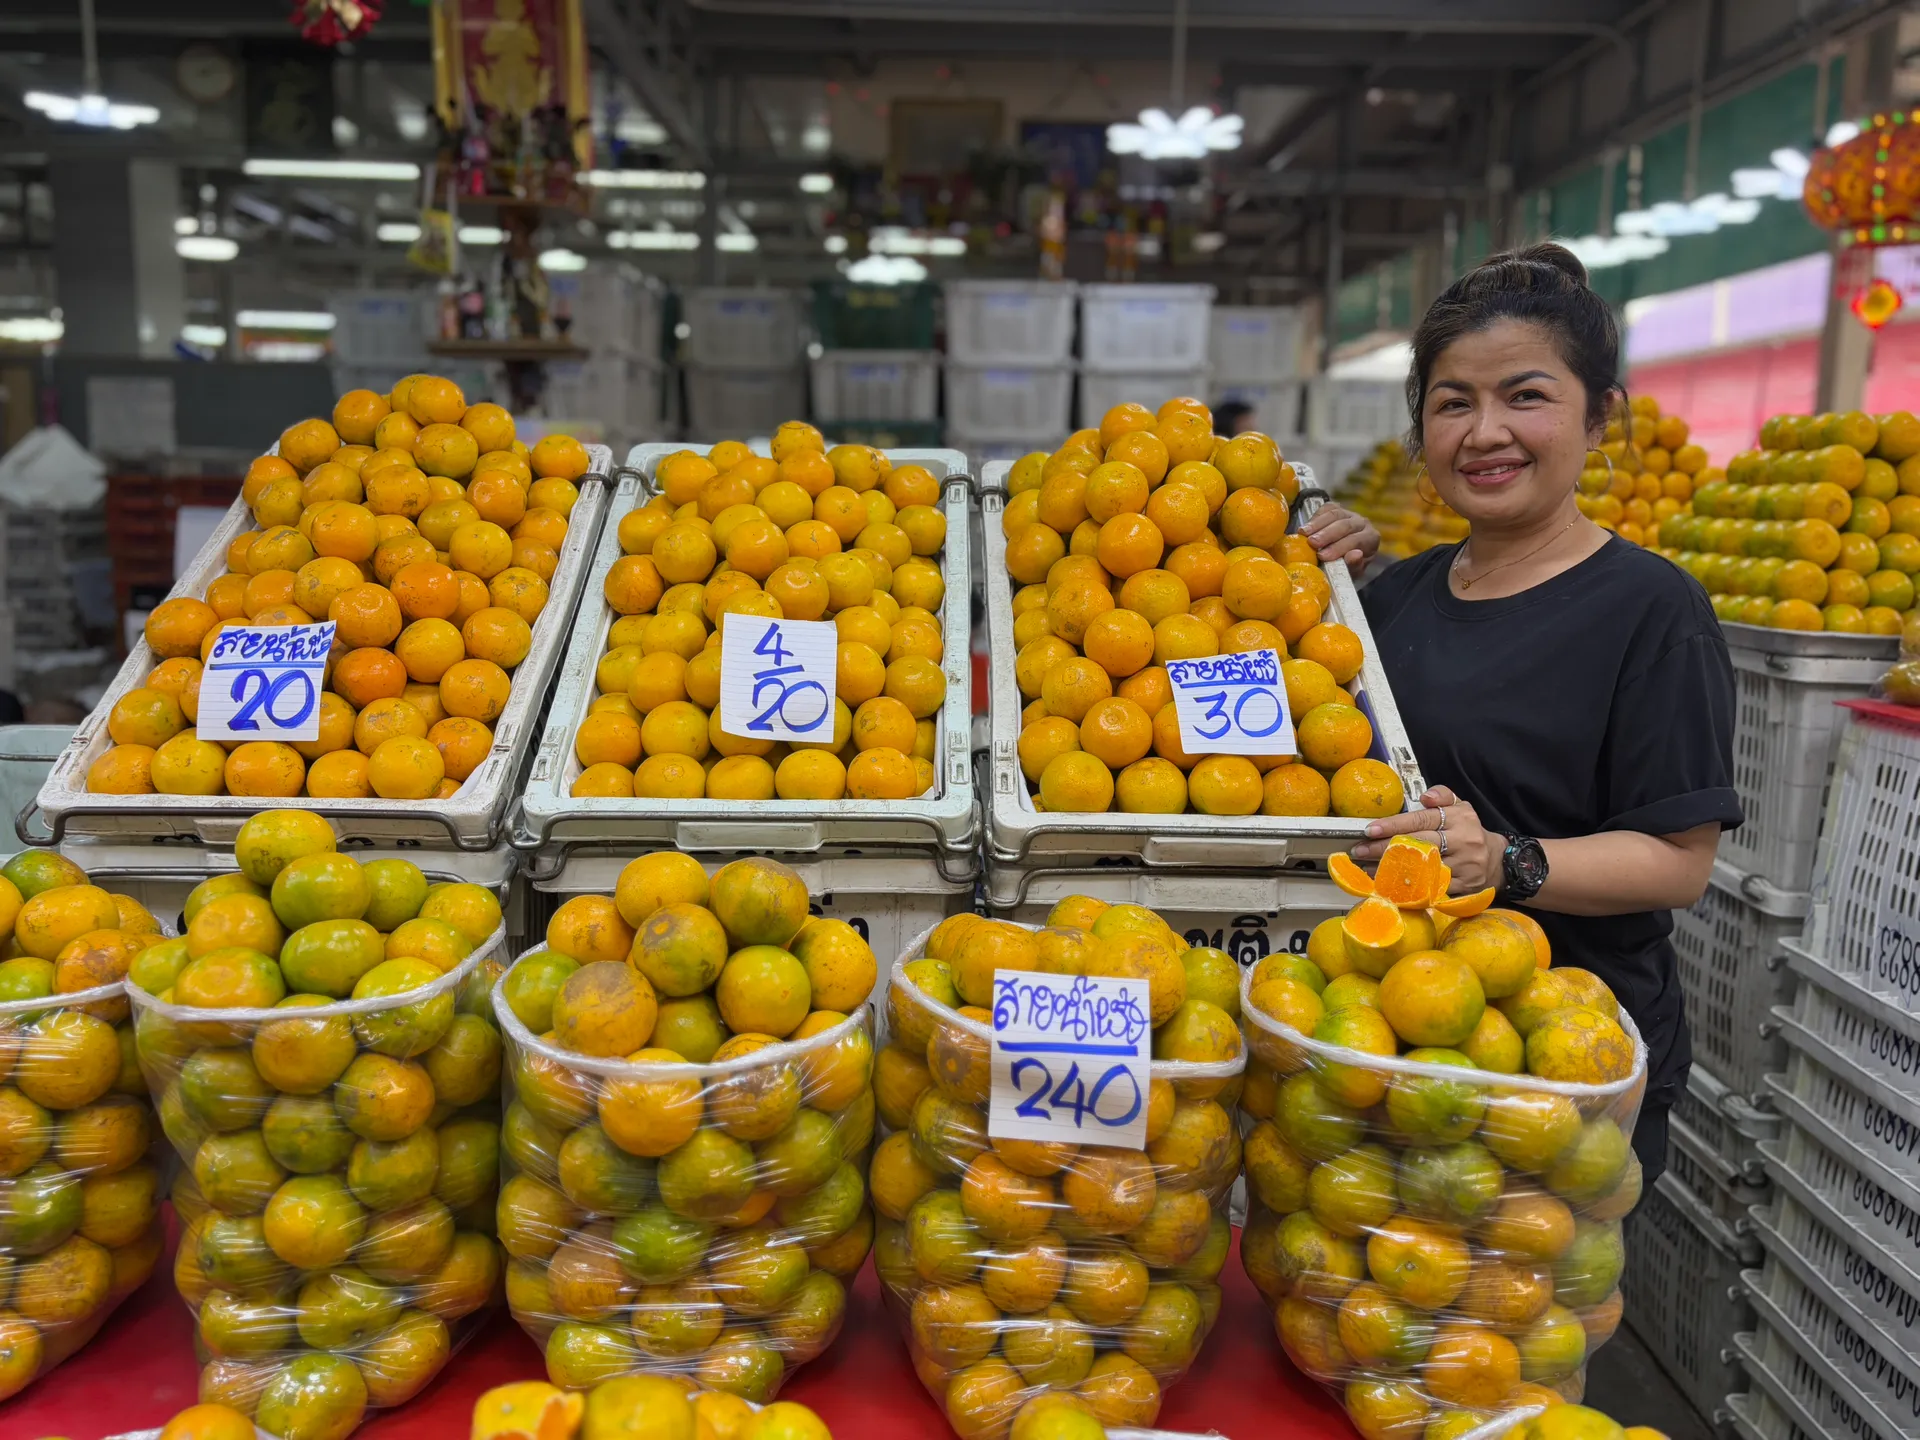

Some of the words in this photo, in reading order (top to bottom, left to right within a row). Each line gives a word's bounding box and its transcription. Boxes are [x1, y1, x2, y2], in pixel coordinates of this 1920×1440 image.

[753, 622, 794, 666] 4
[227, 668, 316, 731] 20
[746, 677, 829, 733] 20
[1192, 687, 1283, 740] 30
[1010, 1057, 1142, 1129] 240
